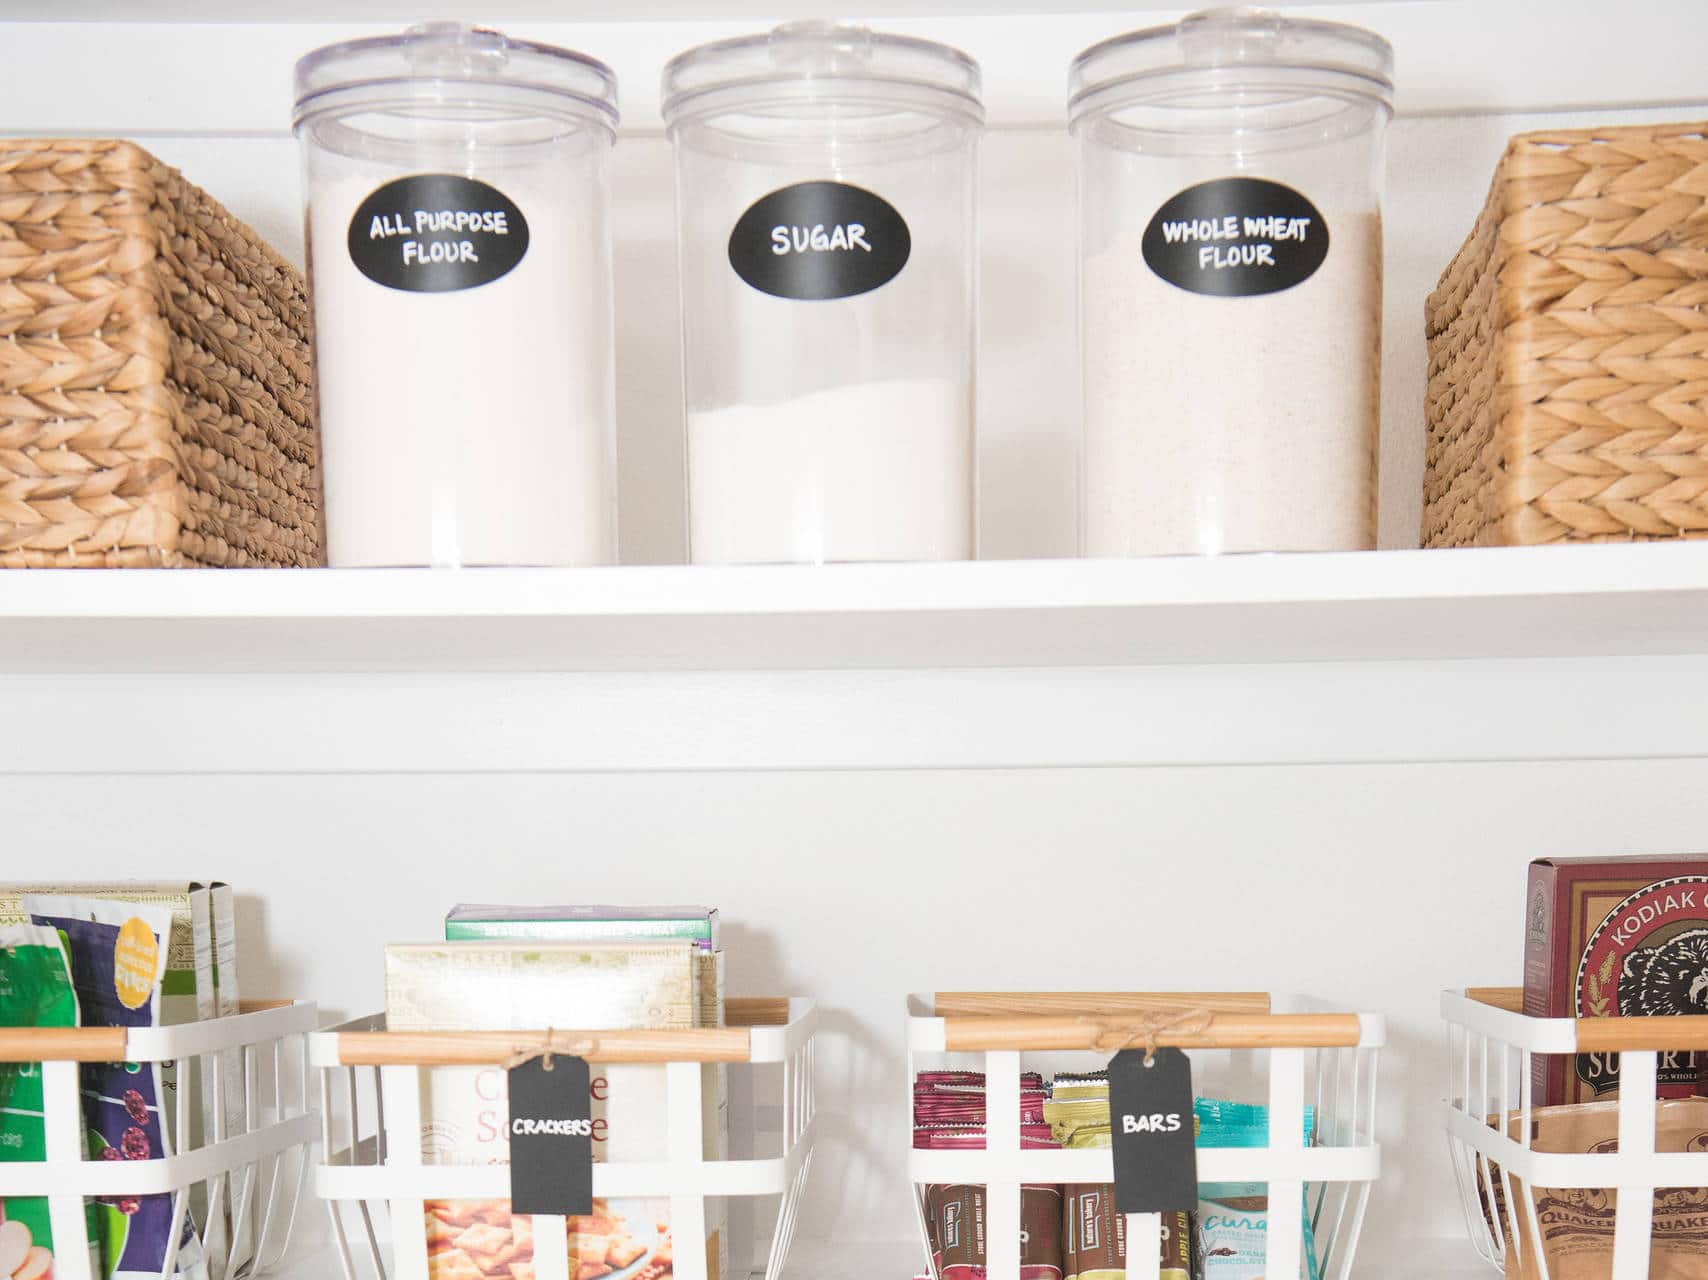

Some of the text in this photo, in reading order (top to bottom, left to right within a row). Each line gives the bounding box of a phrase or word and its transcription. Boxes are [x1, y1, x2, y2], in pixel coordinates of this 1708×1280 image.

[370, 211, 508, 239] ALL PURPOSE
[1162, 216, 1311, 243] WHOLE WHEAT
[770, 224, 871, 255] SUGAR
[402, 241, 479, 265] FLOUR
[1199, 244, 1275, 269] FLOUR
[1611, 891, 1696, 946] KODIAK
[512, 1118, 591, 1135] CRACKERS
[1123, 1114, 1181, 1134] BARS
